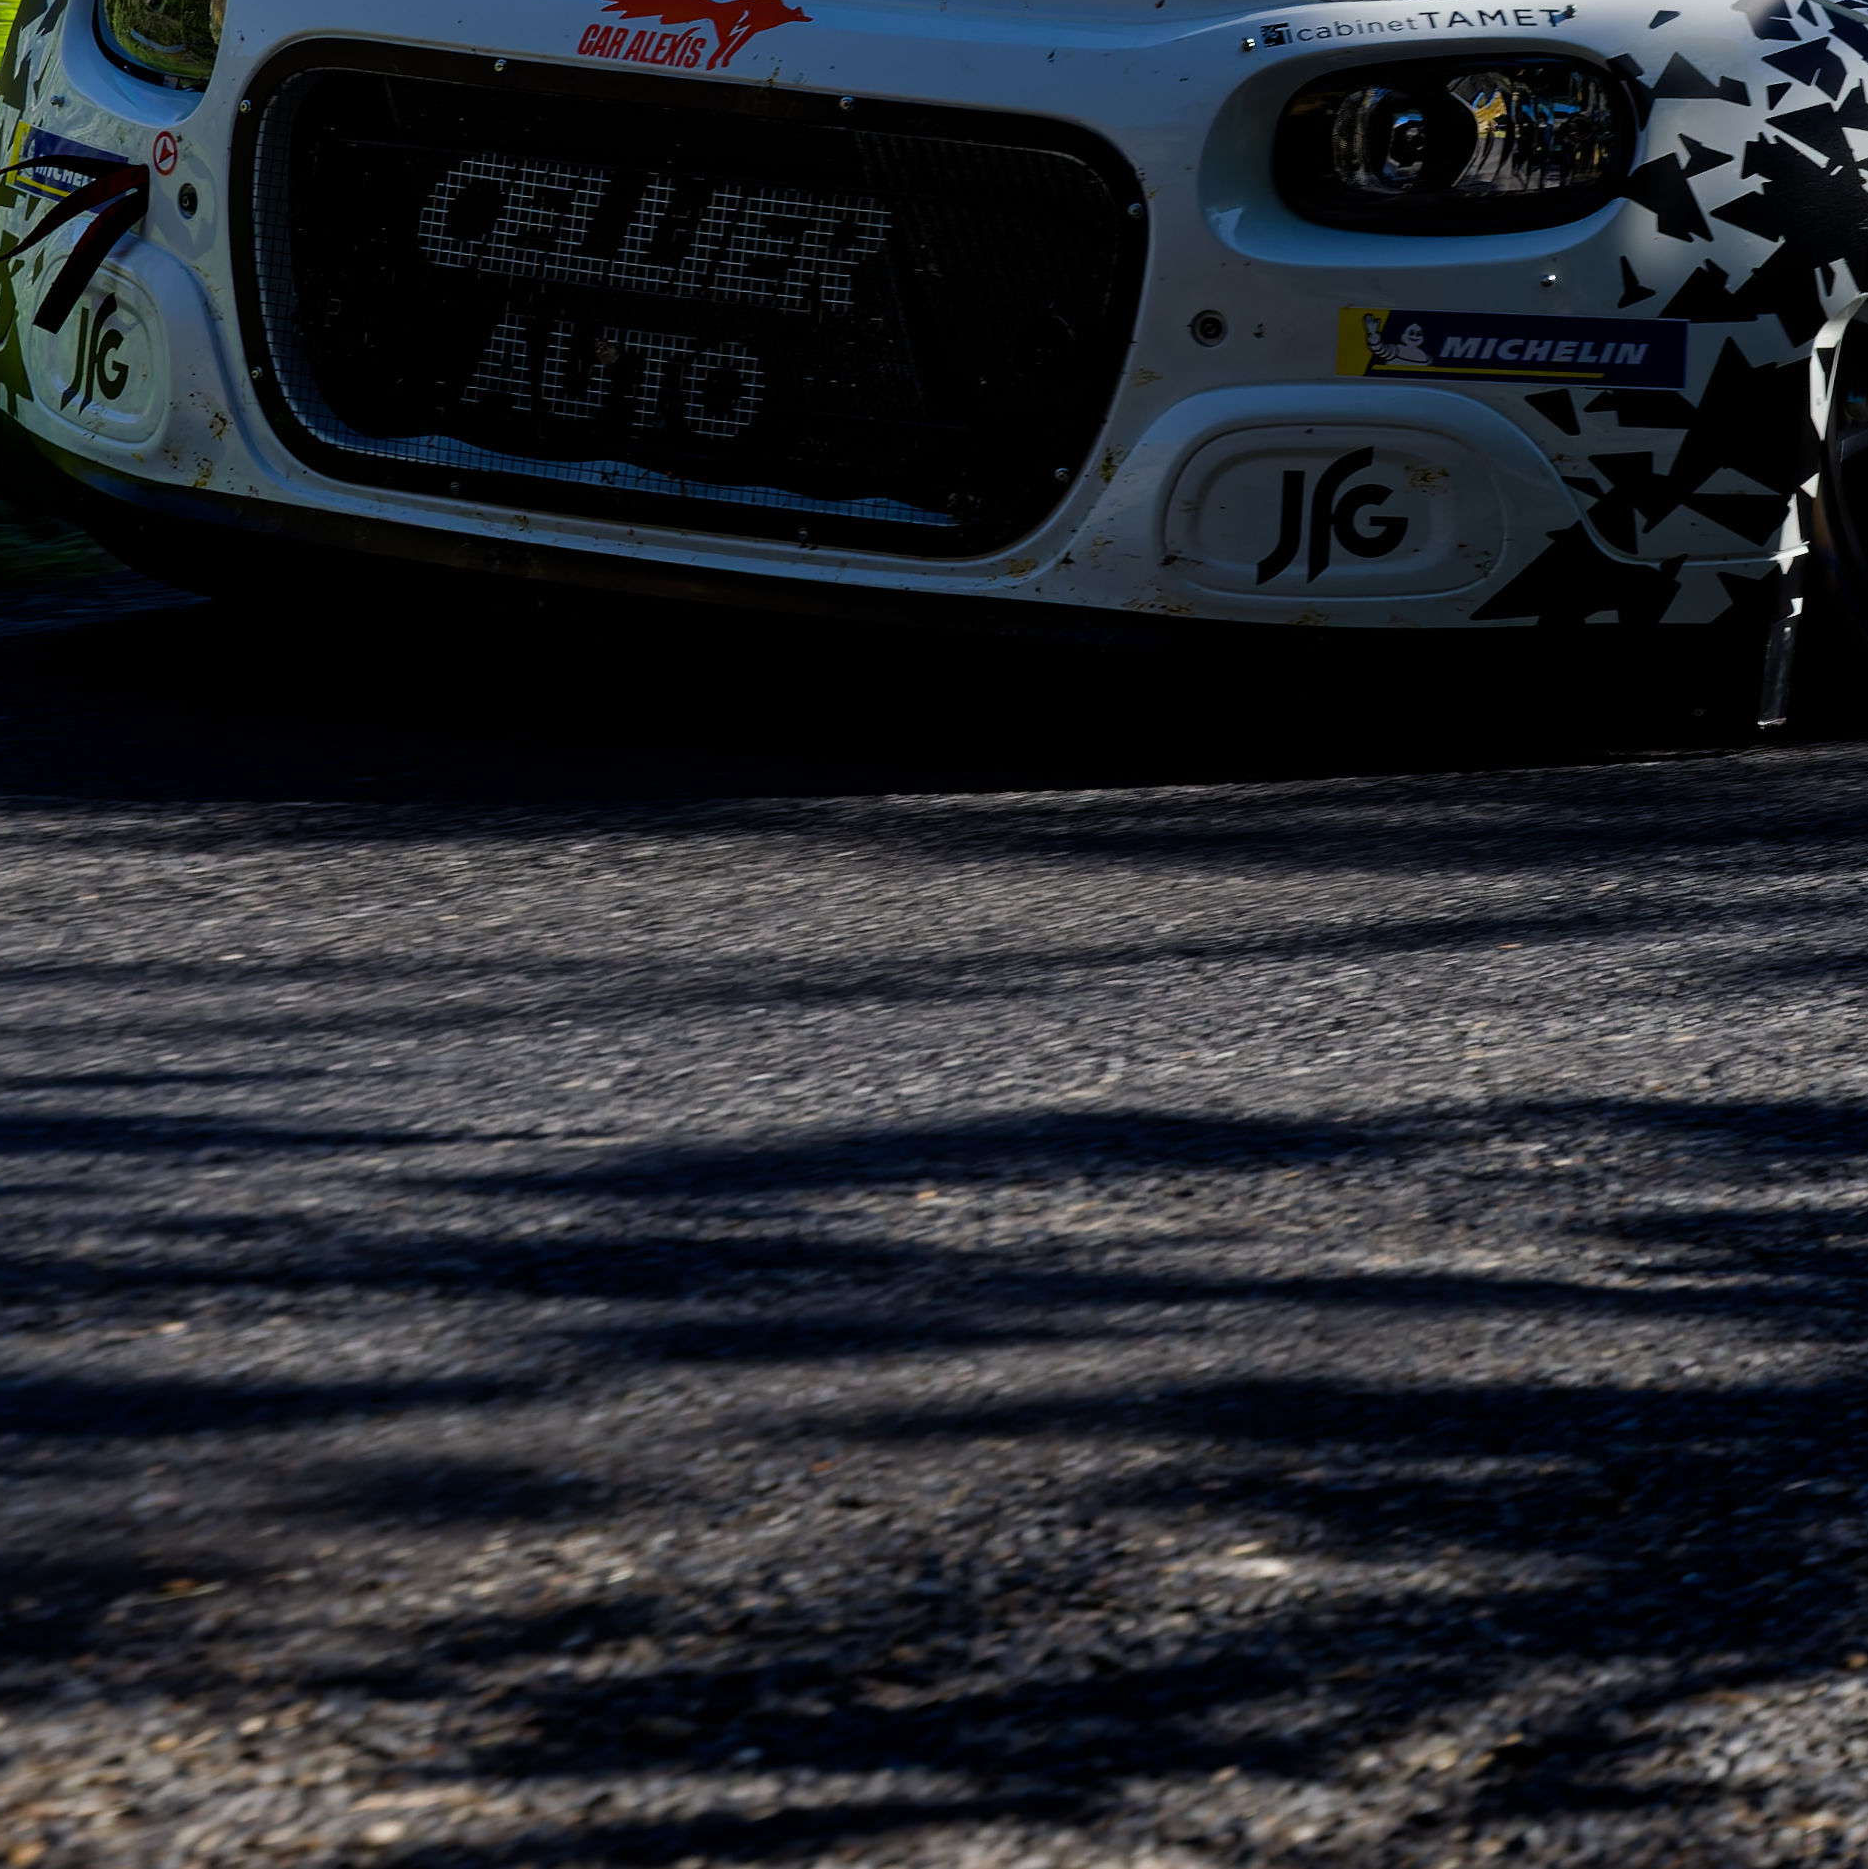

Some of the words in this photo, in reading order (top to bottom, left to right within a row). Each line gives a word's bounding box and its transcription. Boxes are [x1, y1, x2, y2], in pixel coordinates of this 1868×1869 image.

[577, 23, 629, 60] CAR
[624, 26, 707, 69] ALEXIS
[417, 151, 893, 314] CELLIER
[461, 302, 766, 438] AUTO
[1439, 335, 1648, 366] MICHELIN
